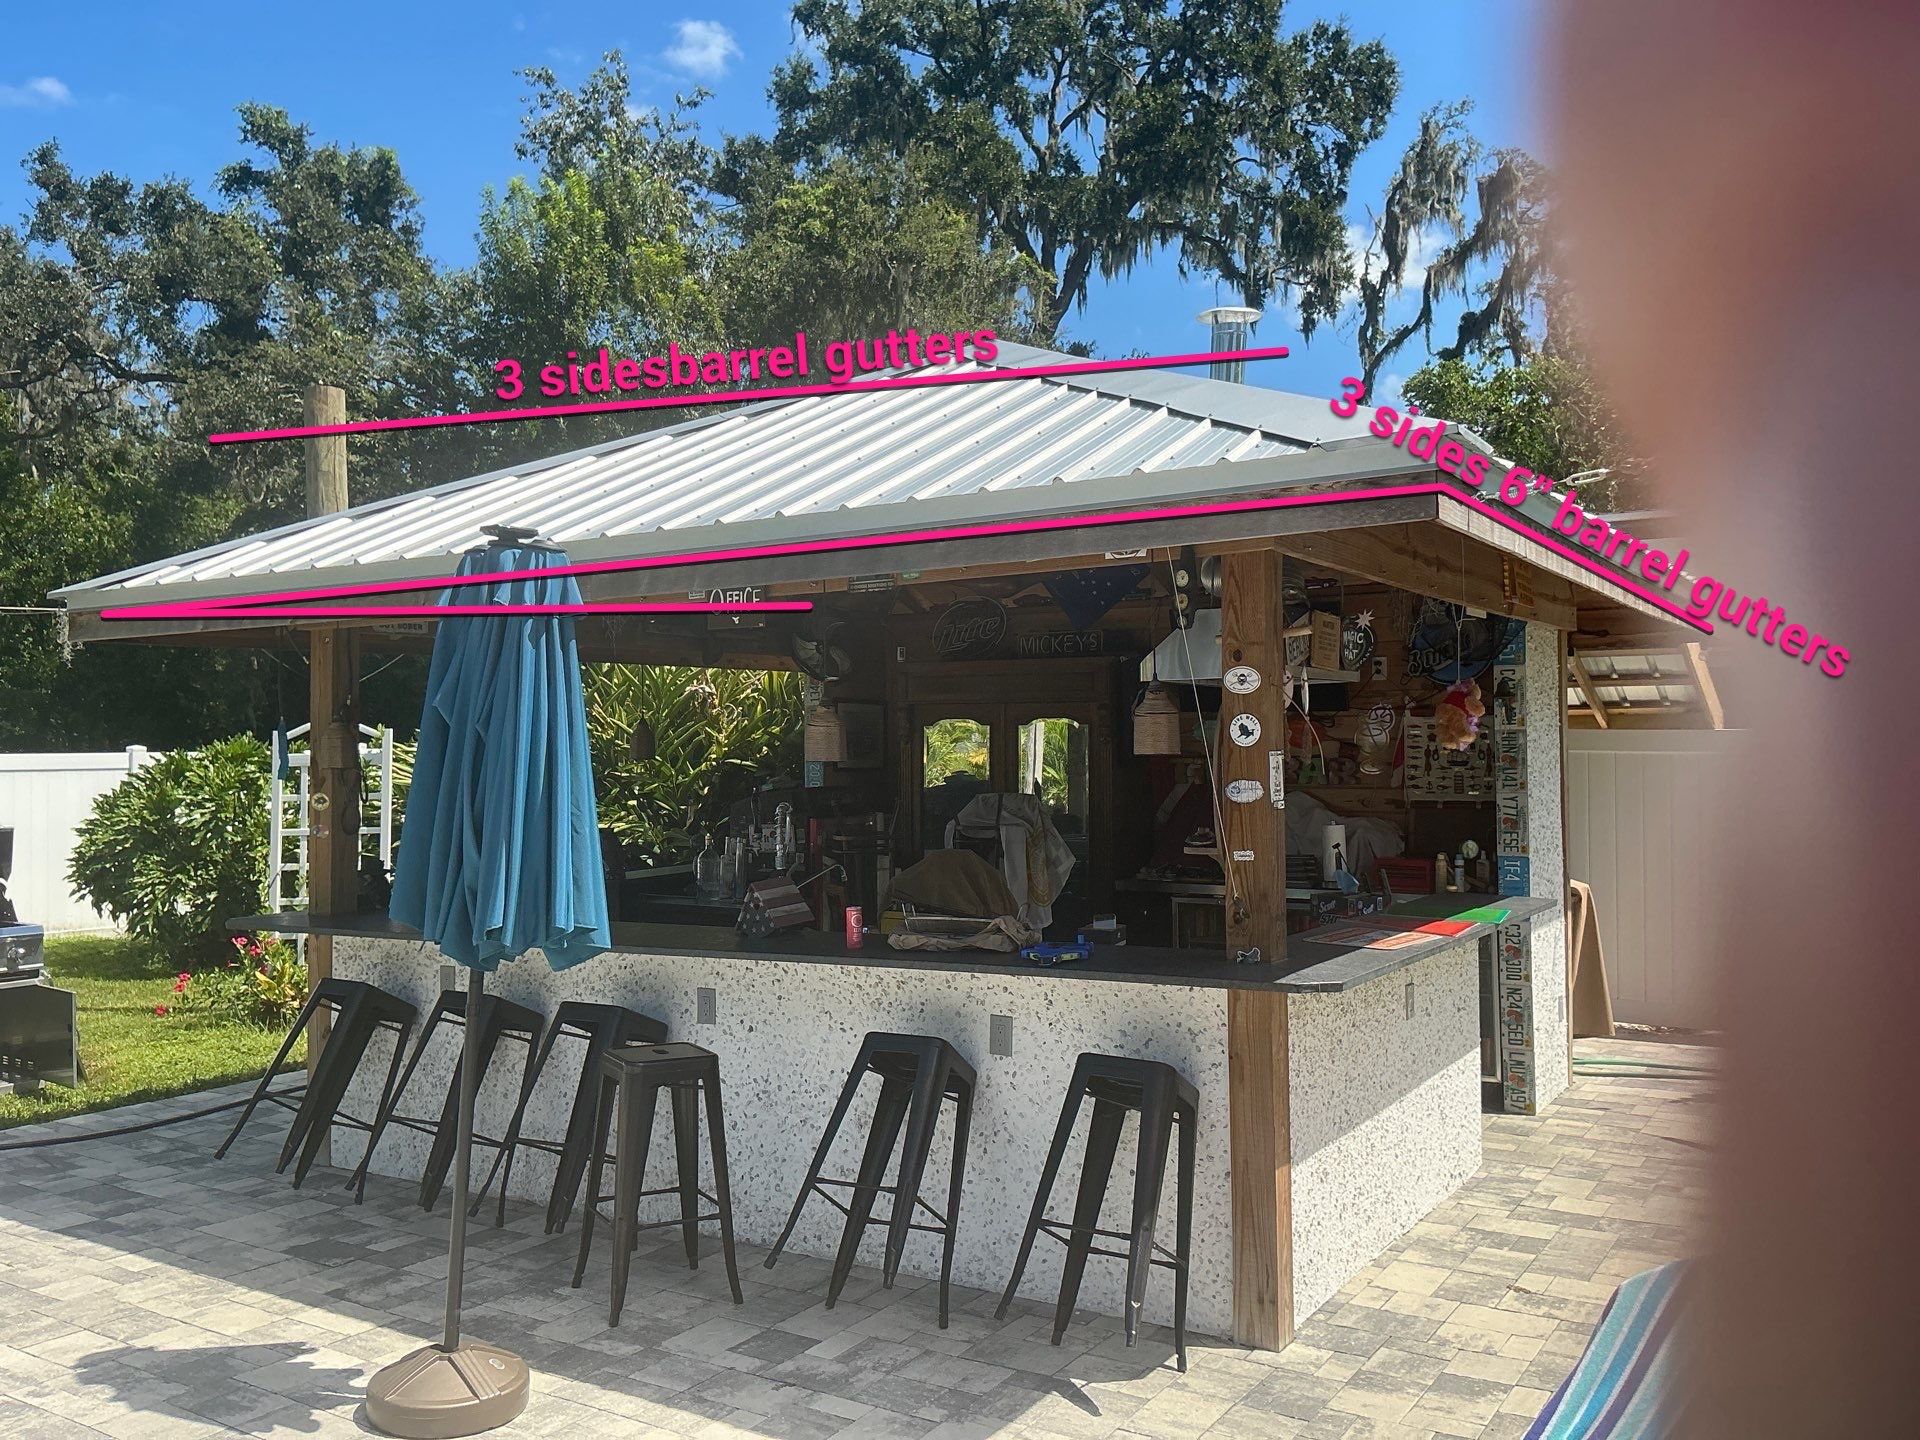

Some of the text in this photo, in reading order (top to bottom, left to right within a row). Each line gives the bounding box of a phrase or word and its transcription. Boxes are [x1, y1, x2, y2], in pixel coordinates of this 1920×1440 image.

[1503, 831, 1519, 852] FSE
[1506, 988, 1523, 1008] N24
[1510, 1088, 1527, 1111] A97
